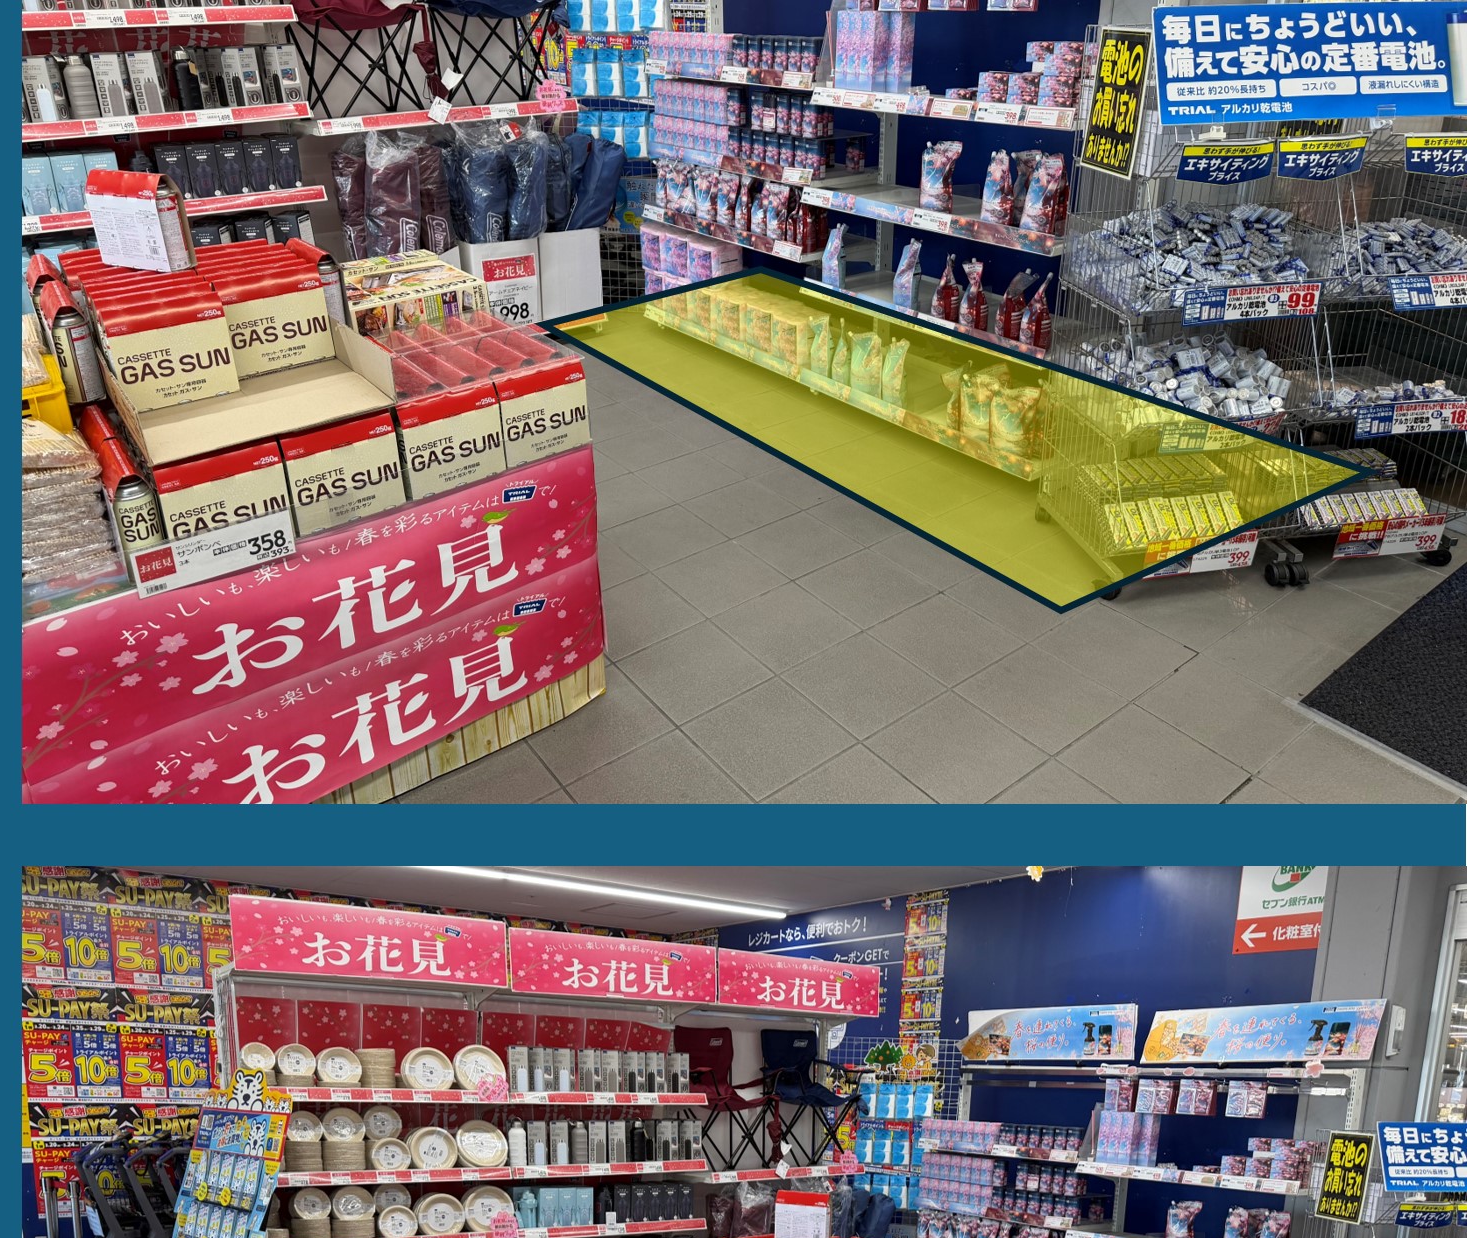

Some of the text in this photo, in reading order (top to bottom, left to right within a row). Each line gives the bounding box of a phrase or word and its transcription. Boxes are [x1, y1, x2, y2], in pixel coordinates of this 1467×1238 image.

[1162, 12, 1418, 45] 毎日にちょうどいい、
[1099, 39, 1144, 88] 電池の
[1163, 40, 1446, 79] 備えて安心の定番電池。
[1176, 82, 1266, 97] 従来比 約20%長持ち
[1367, 79, 1440, 91] 液漏れしにくい構造
[1092, 86, 1138, 135] お買い忘れ
[1168, 105, 1216, 116] TRIAL
[1221, 101, 1294, 115] アルカリ乾電池
[1184, 154, 1269, 171] エキサイティング
[1208, 171, 1241, 182] プライス
[493, 263, 526, 279] お花見
[1287, 291, 1317, 308] 99
[228, 315, 277, 333] CASSETTE
[231, 314, 328, 350] GAS SUN
[117, 348, 172, 366] CASSETTE
[120, 346, 231, 386] GAS SUN
[505, 408, 546, 426] CASSETTE
[506, 404, 587, 442] GAS SUN
[408, 435, 454, 455] CASSETTE
[410, 430, 501, 472] GAS SUN
[294, 466, 346, 493] CASSETTE
[296, 459, 401, 507] GAS SUN
[120, 506, 161, 543] GAS SUN
[247, 529, 287, 556] 358
[270, 546, 290, 558] 393
[1228, 550, 1250, 564] 399
[191, 523, 520, 696] お花見
[220, 637, 528, 803] お花見
[748, 916, 868, 947] レジカートなら、便利でおトク!
[64, 936, 111, 969] 10倍
[301, 931, 453, 977] お花見
[562, 957, 674, 997] お花見
[125, 1055, 166, 1086] 5倍
